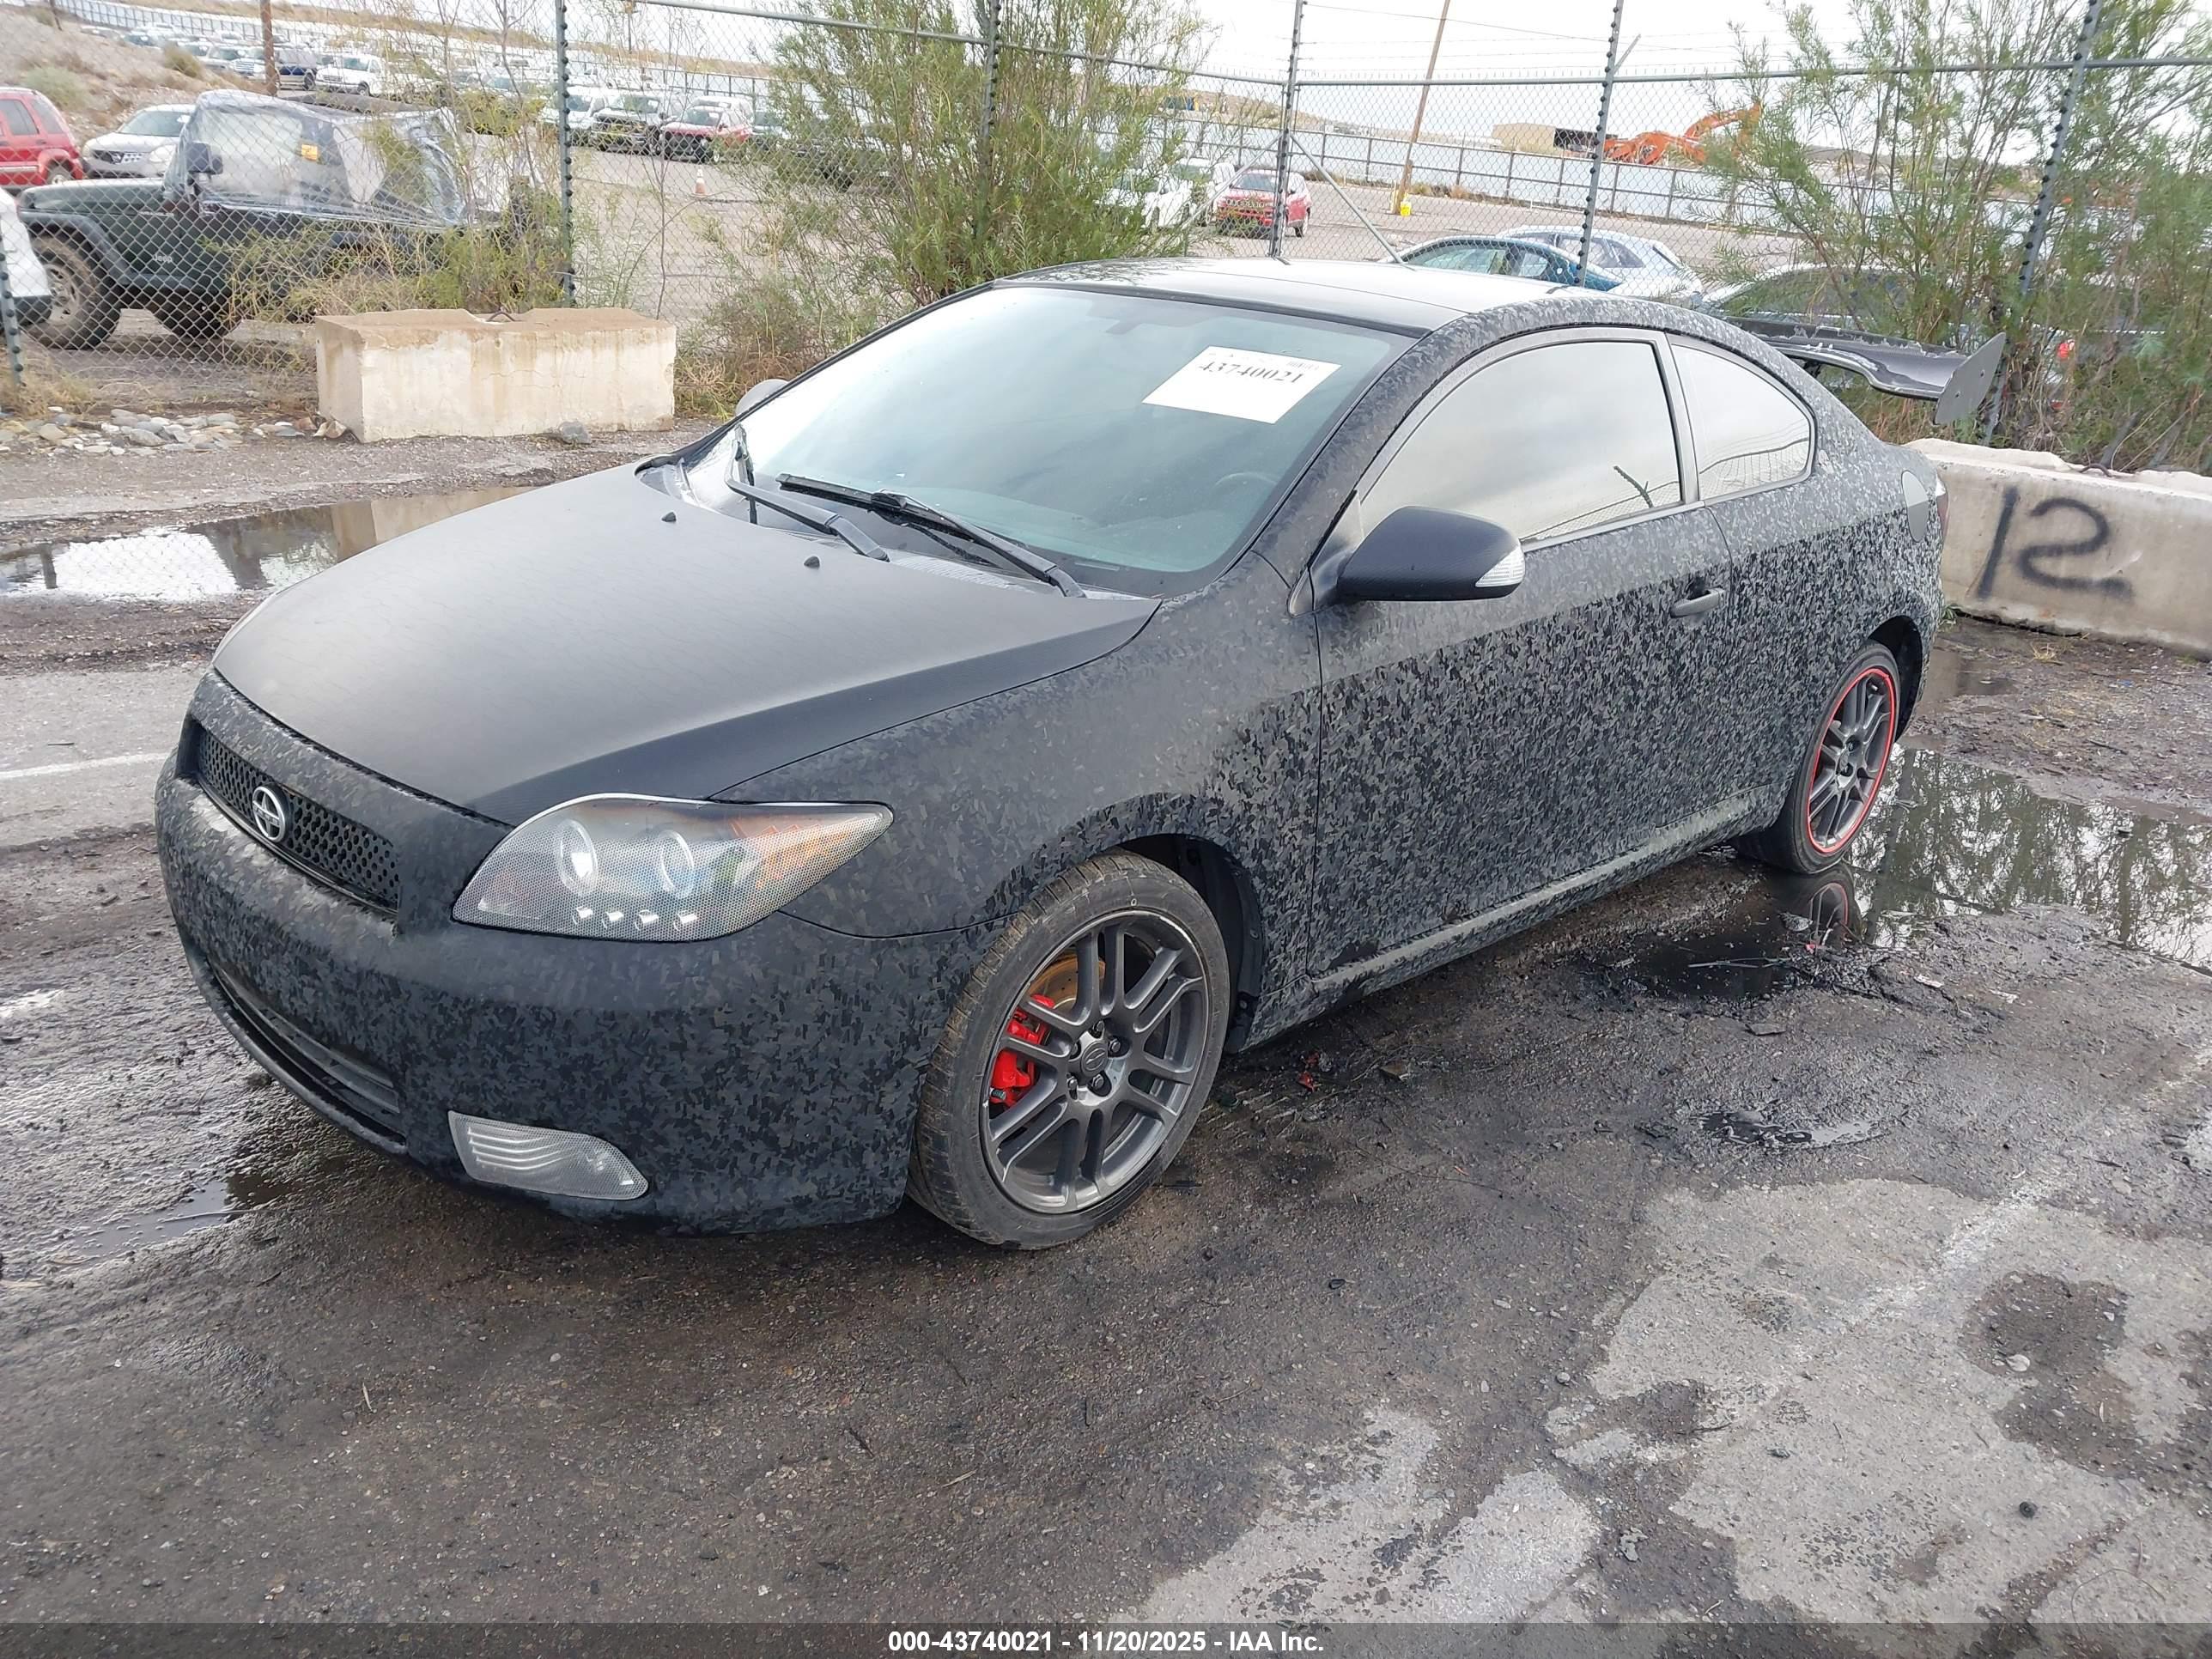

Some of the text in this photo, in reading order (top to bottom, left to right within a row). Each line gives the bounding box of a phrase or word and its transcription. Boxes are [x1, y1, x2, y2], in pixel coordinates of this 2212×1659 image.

[153, 252, 173, 264] Jeep
[1199, 361, 1304, 383] 43740021
[1977, 485, 2135, 601] 12
